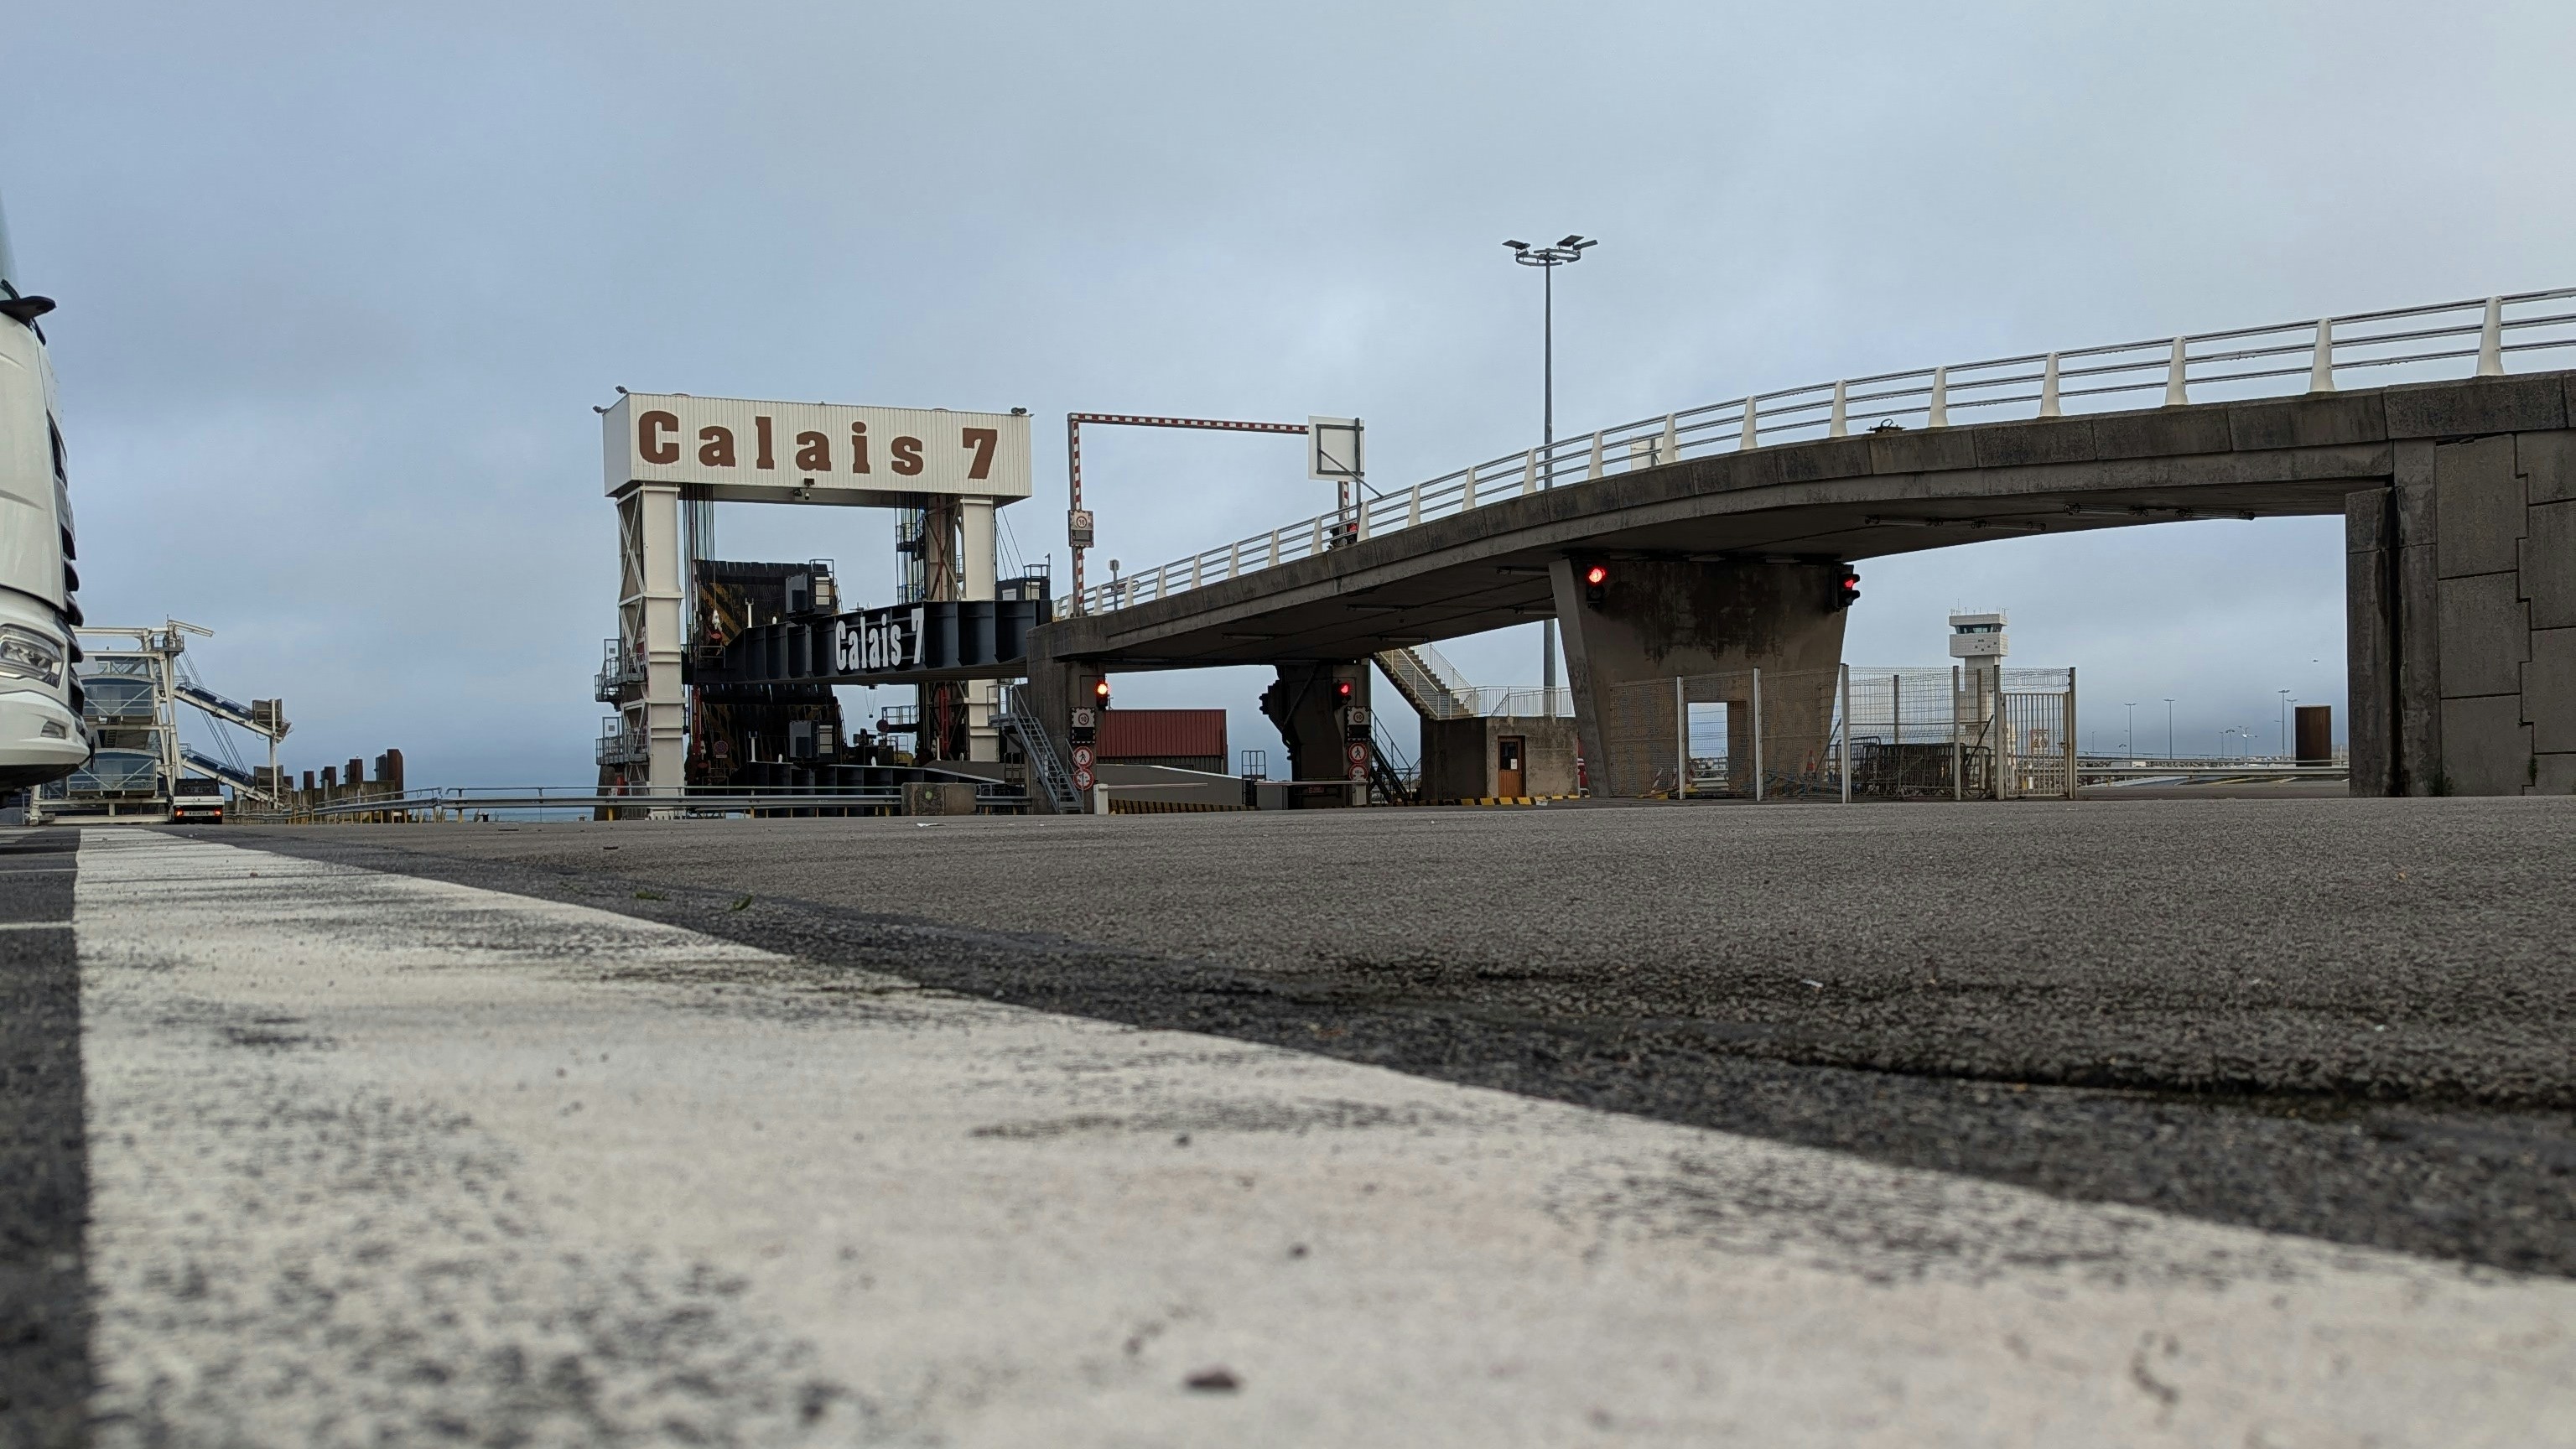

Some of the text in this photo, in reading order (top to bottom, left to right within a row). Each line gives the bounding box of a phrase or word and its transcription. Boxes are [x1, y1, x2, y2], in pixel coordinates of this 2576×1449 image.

[638, 410, 998, 480] Calais 7
[836, 608, 924, 671] Calais 7
